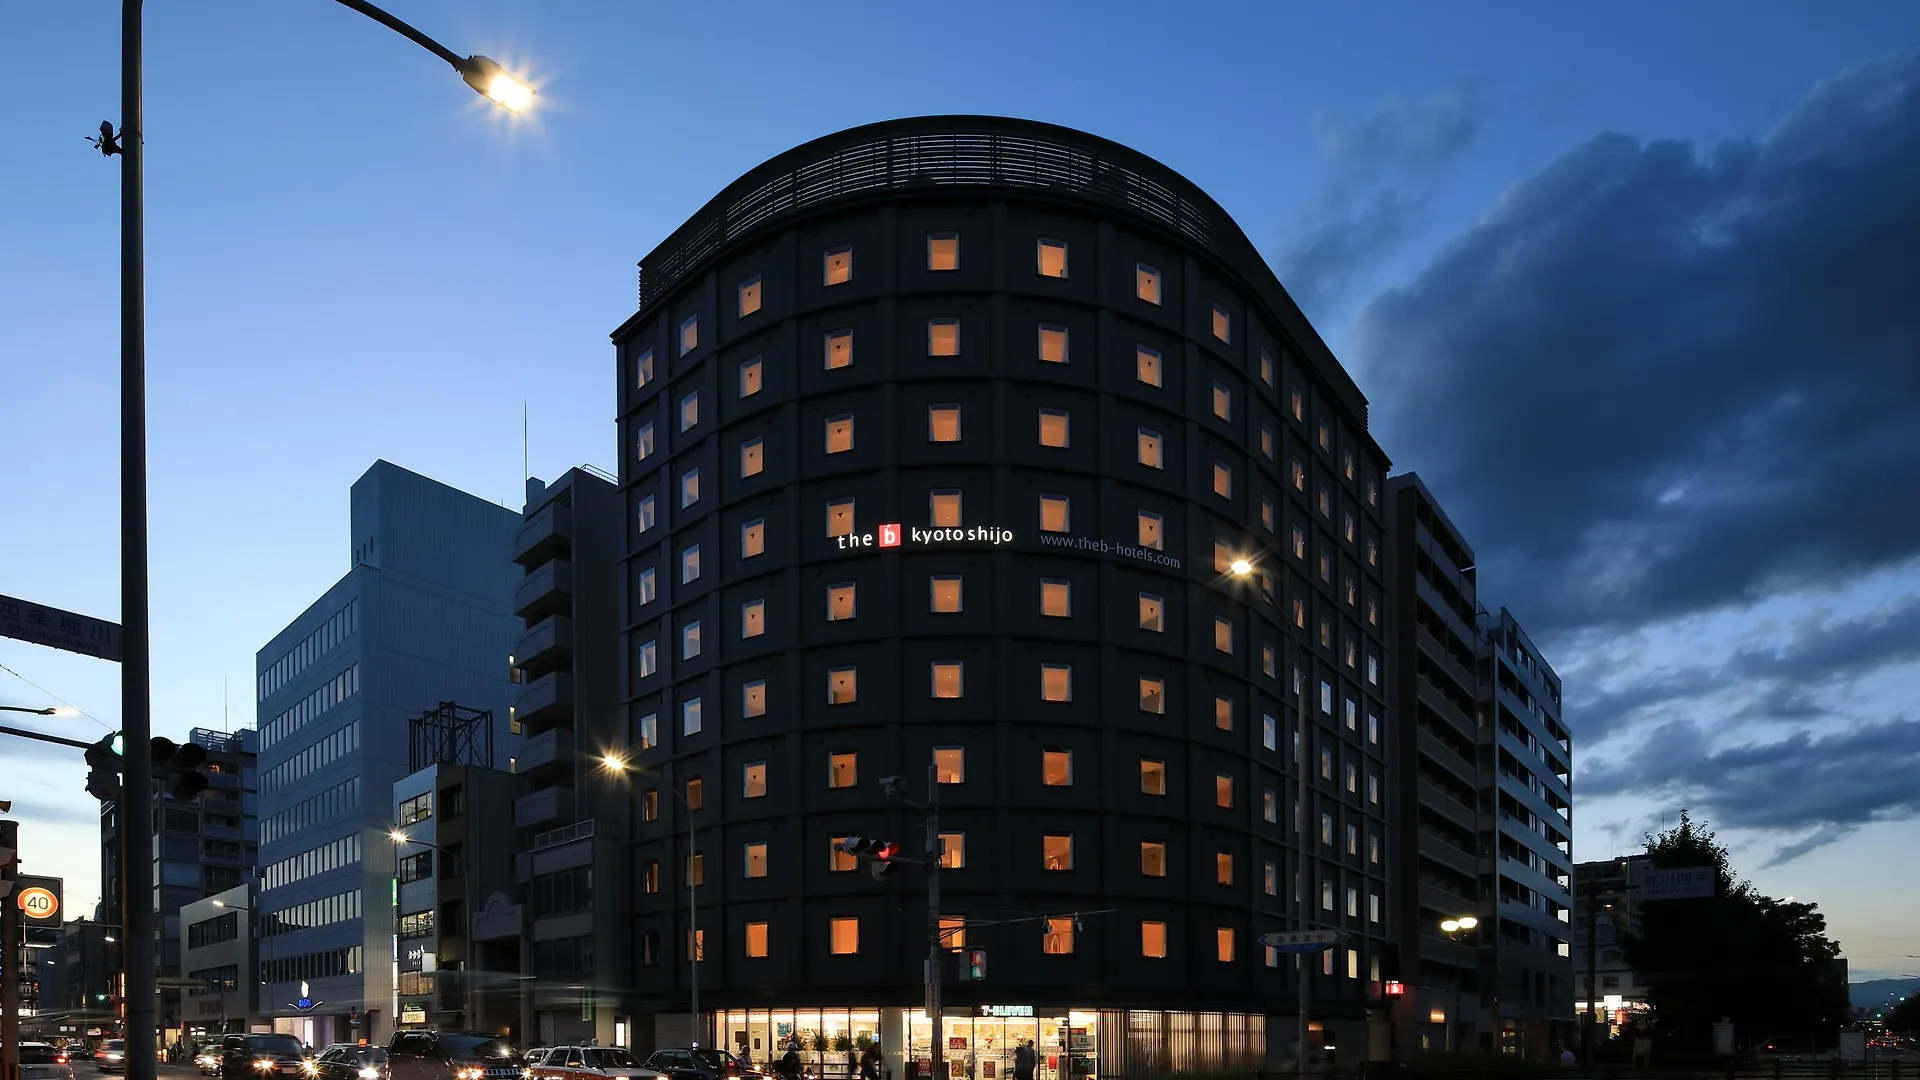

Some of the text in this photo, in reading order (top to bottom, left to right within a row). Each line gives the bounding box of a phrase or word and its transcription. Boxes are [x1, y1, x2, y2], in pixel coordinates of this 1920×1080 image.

[837, 532, 873, 549] the
[911, 526, 964, 545] kyoto
[968, 525, 1013, 545] shijo
[1040, 534, 1181, 569] www.theb-hotels.com
[27, 896, 49, 910] 40
